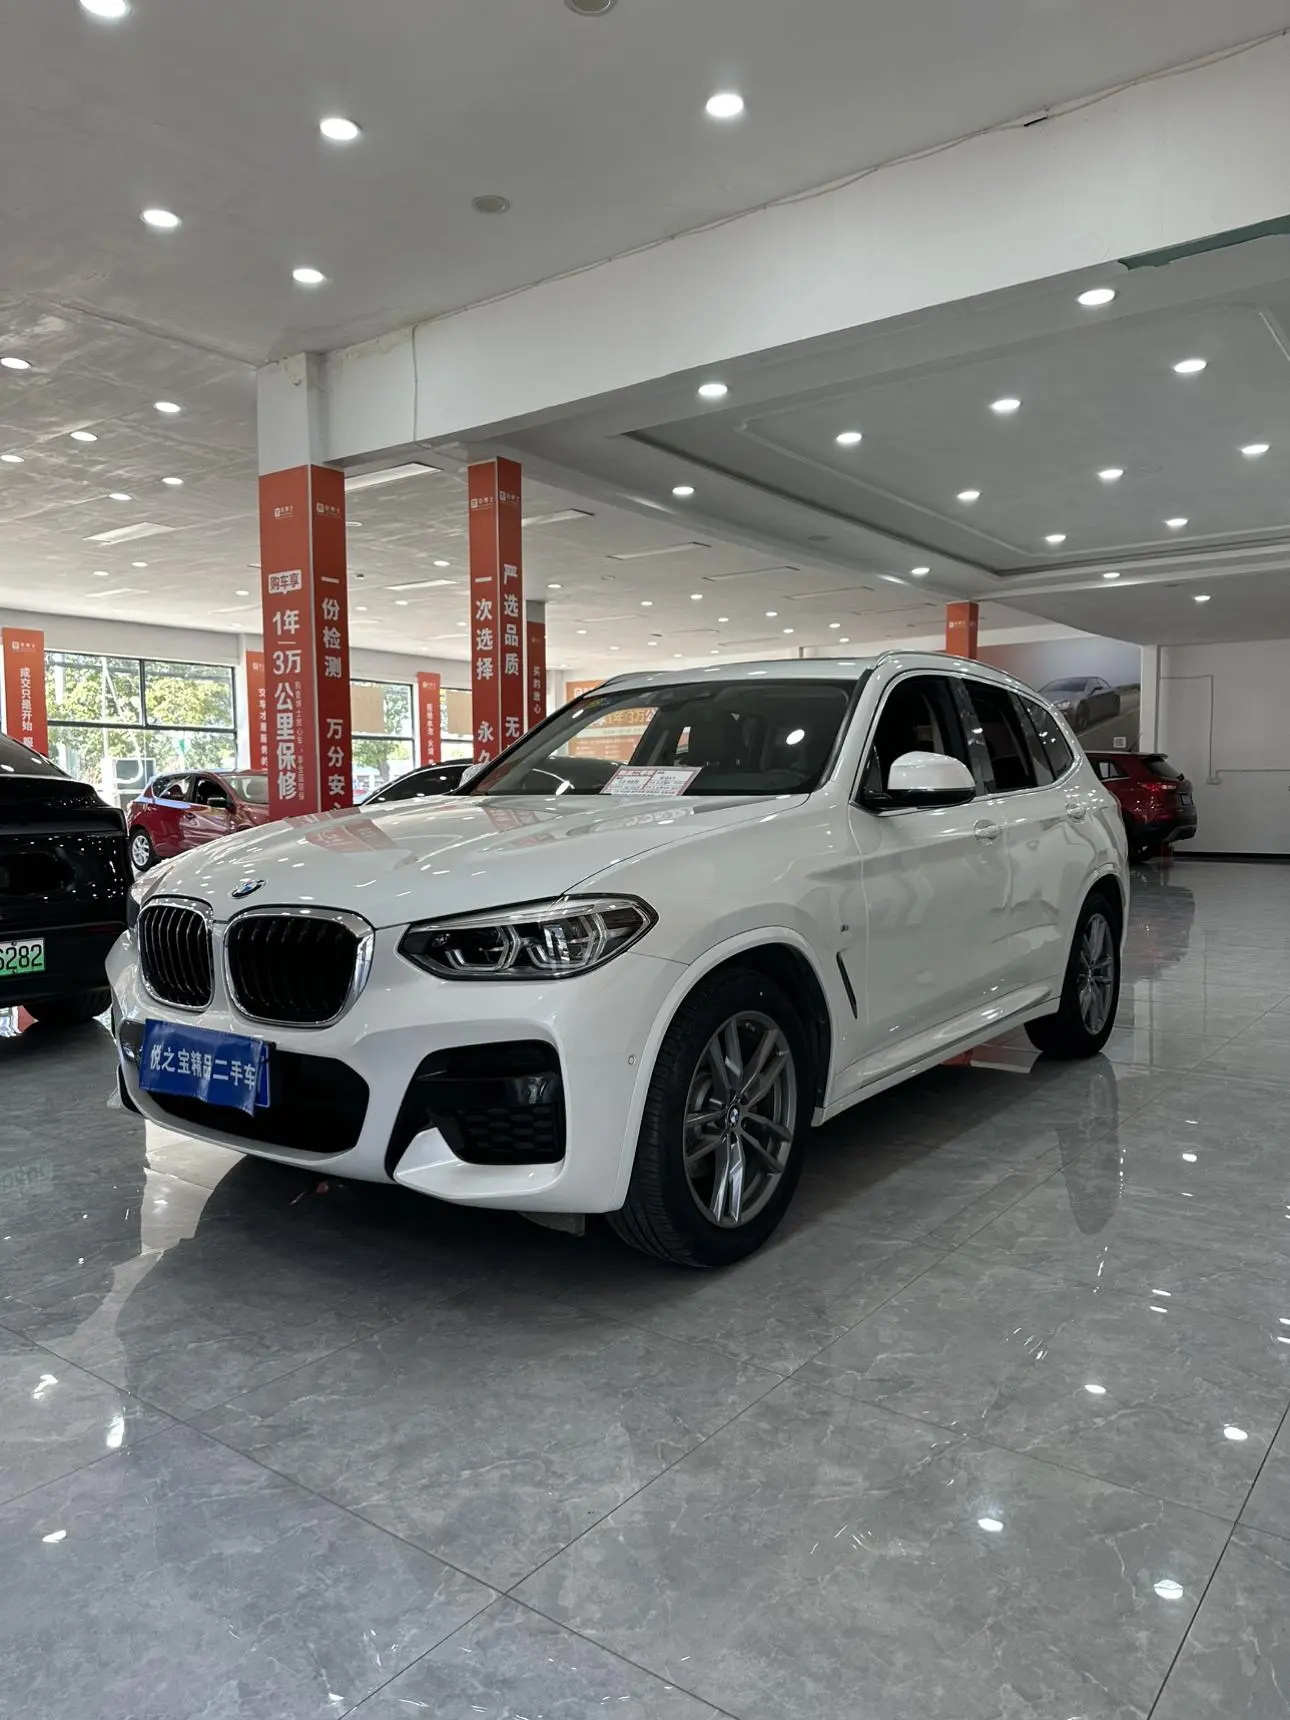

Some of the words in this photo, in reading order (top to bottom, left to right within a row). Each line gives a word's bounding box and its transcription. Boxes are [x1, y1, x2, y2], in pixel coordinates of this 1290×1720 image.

[270, 572, 299, 591] 购车享
[321, 576, 342, 679] 一份检测
[475, 575, 494, 681] 一次选择
[503, 564, 519, 676] 严选品质
[326, 718, 345, 811] 万分安
[505, 717, 520, 748] 无
[150, 1044, 256, 1091] 悦之宝精品二手车
